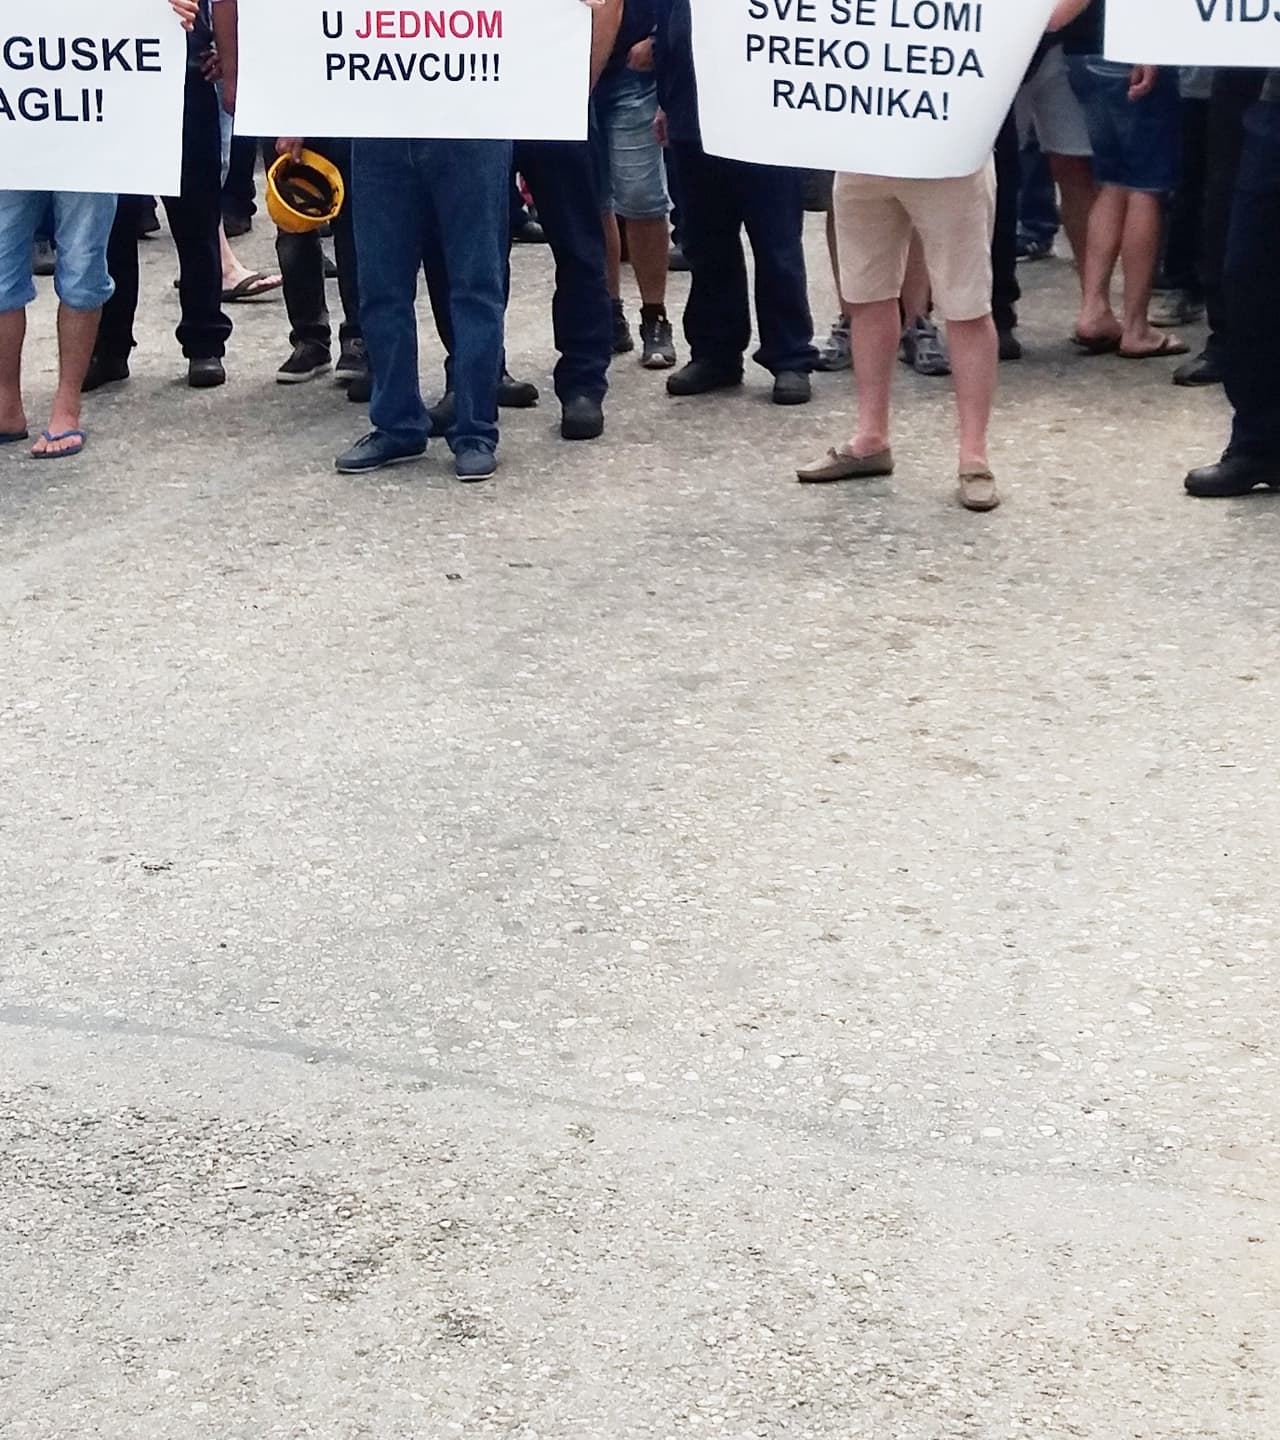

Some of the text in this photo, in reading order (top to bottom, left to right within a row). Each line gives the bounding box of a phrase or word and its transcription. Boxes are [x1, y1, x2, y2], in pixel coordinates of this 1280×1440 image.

[322, 10, 504, 39] U JEDNOM
[2, 35, 162, 73] GUSKE
[325, 52, 500, 82] PRAVCU!!!
[746, 33, 985, 79] PREKO LEĐA
[773, 78, 949, 121] RADNIKA!
